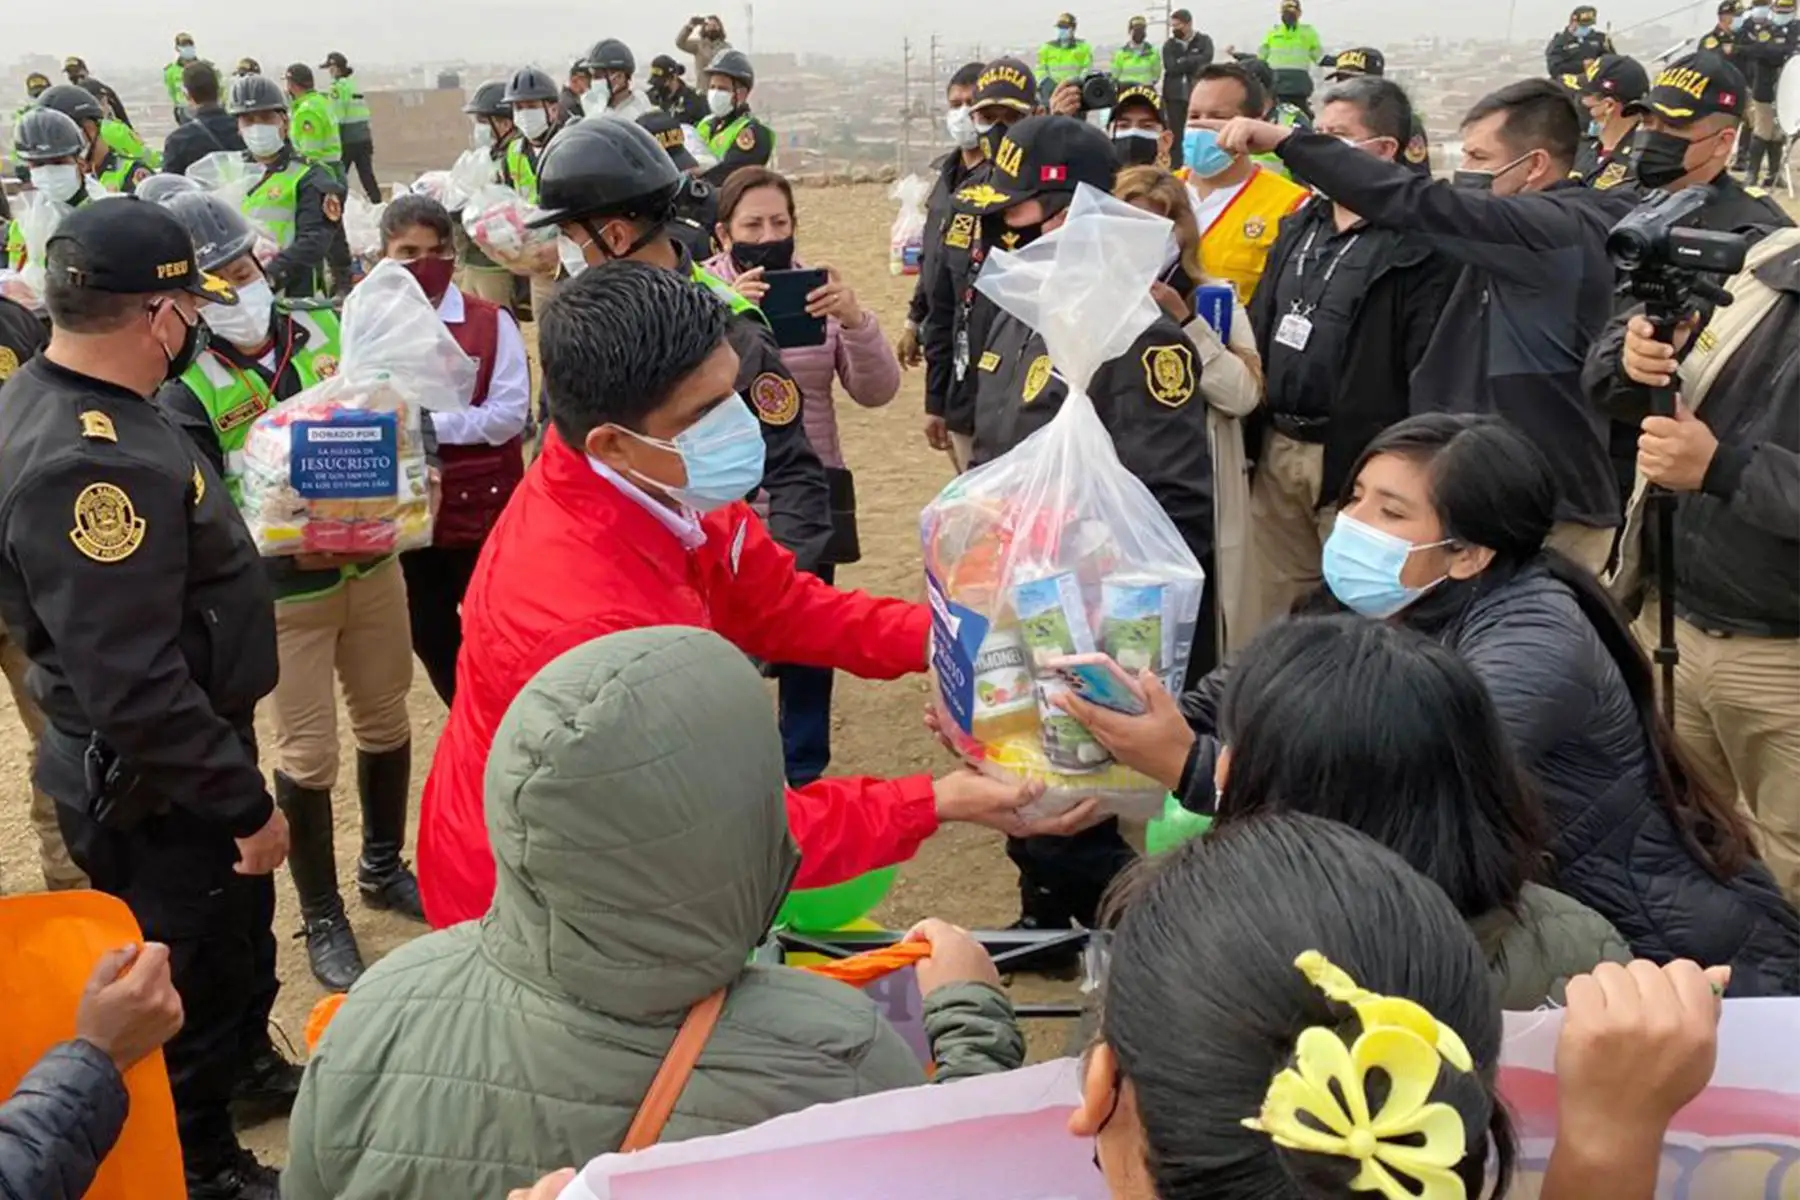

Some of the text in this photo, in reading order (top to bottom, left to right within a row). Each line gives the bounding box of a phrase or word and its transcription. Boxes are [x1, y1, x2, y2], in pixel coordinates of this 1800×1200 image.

[976, 65, 1027, 92] POLICIA
[311, 430, 354, 439] DONADO
[300, 455, 391, 472] JESUCRISTO
